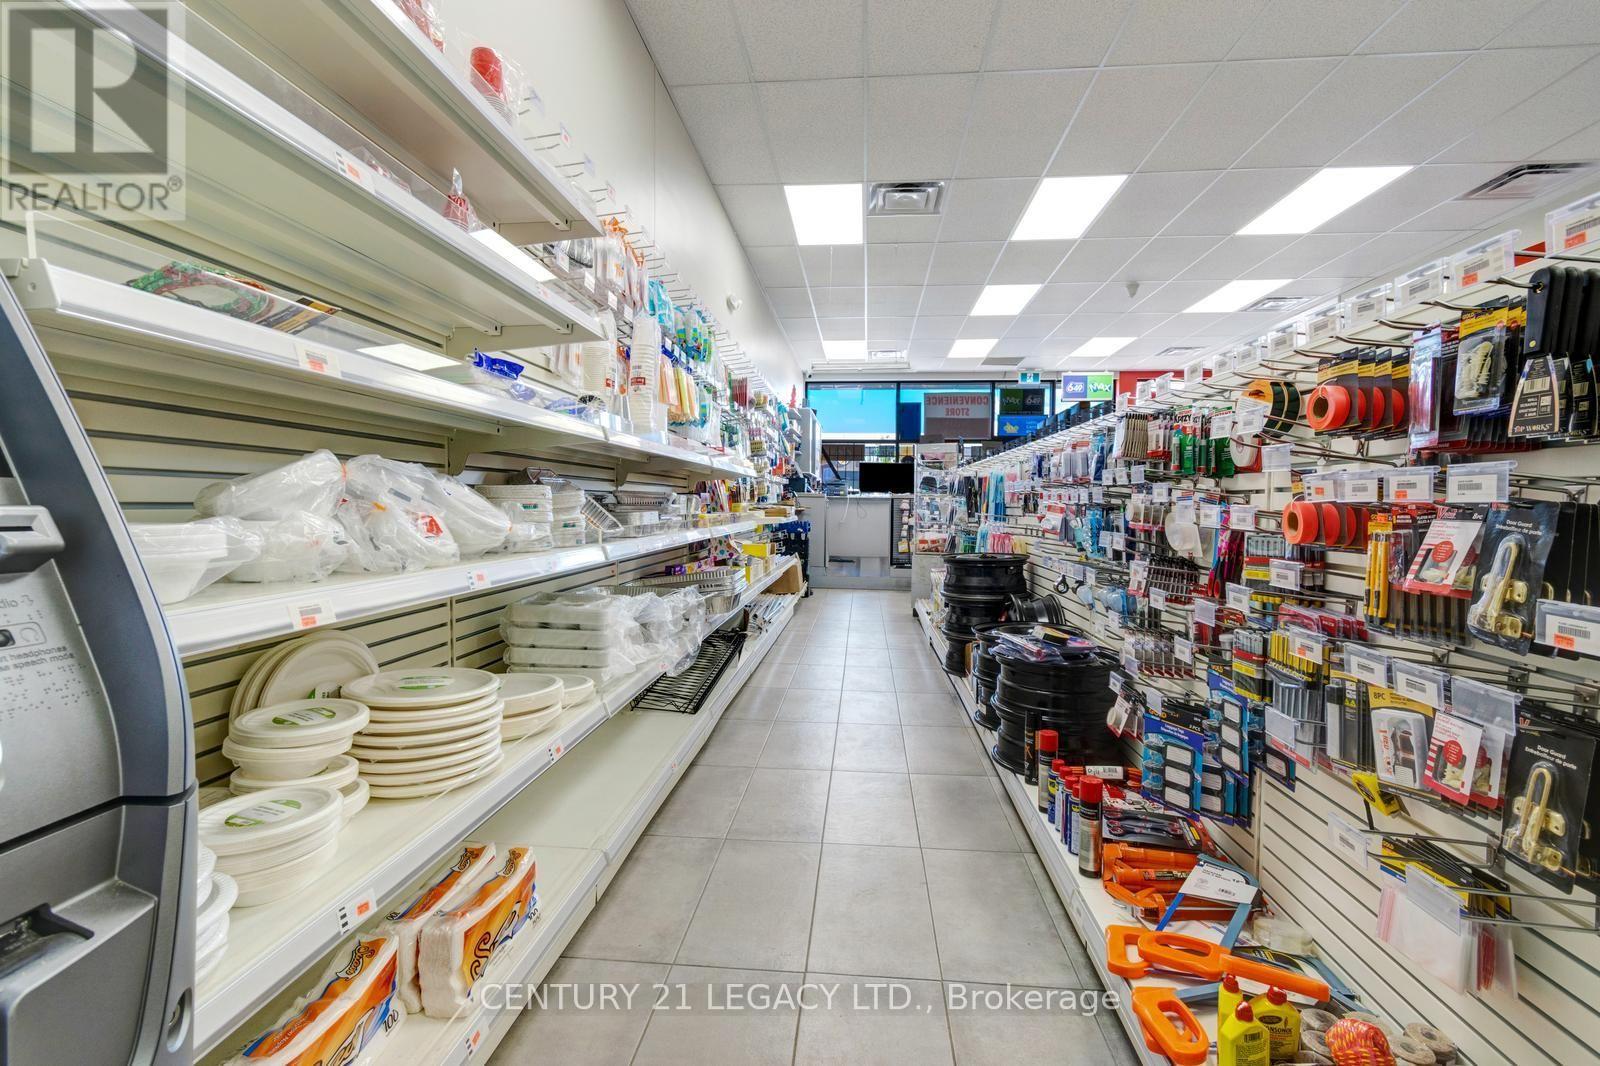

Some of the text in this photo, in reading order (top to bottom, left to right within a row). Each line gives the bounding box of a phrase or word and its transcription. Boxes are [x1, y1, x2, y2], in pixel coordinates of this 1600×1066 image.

[10, 646, 67, 660] headphones
[14, 657, 48, 669] speech
[49, 653, 75, 662] mode
[1373, 691, 1386, 700] 8PC
[1537, 744, 1567, 760] Door Guard
[1562, 761, 1577, 771] porte
[382, 1008, 400, 1033] 100
